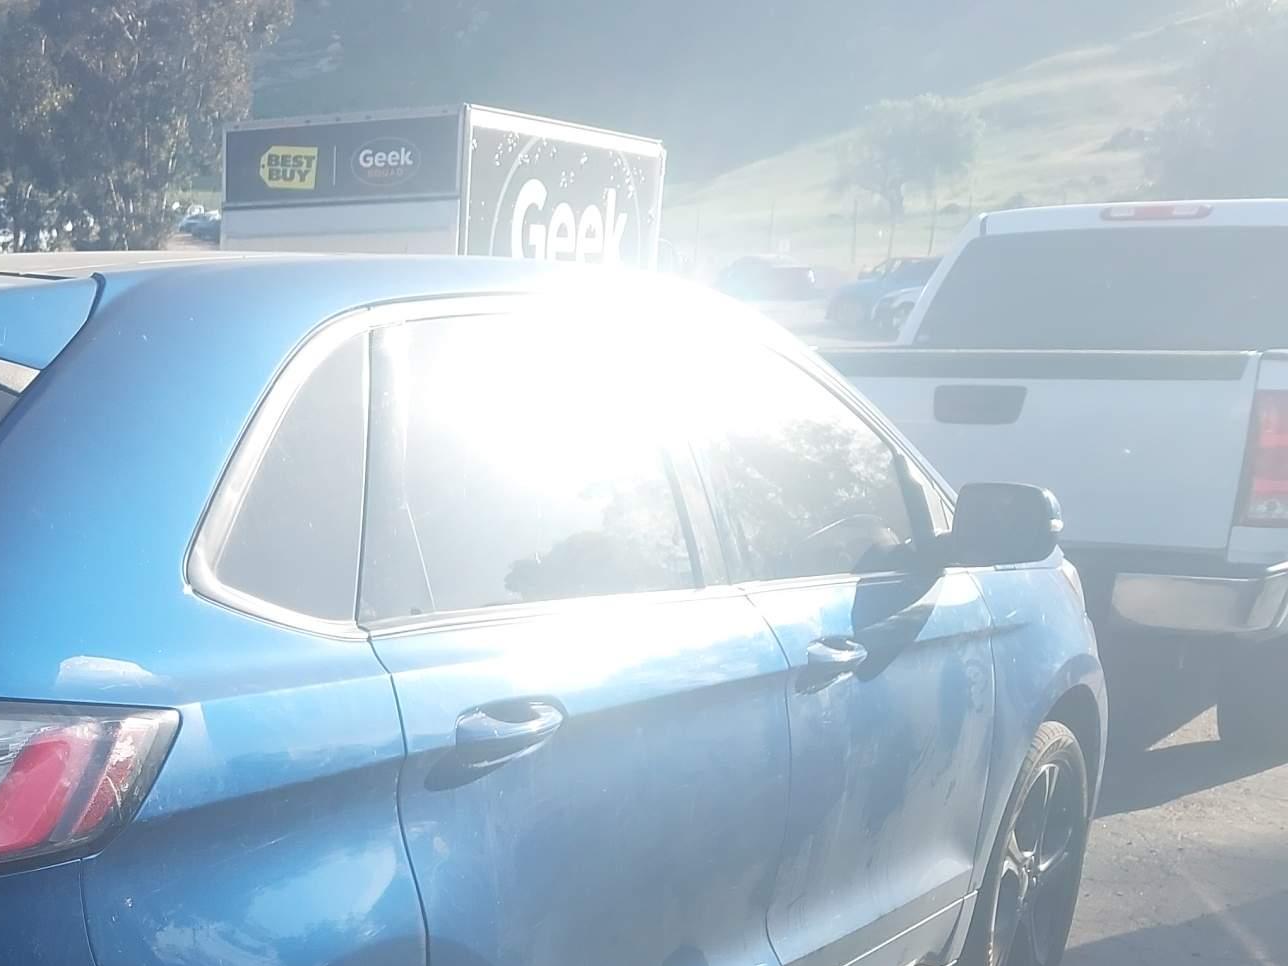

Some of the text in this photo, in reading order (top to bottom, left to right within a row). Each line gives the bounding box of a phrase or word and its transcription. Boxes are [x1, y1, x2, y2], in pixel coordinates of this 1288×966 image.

[267, 154, 316, 169] BEST
[358, 147, 414, 169] Geek
[268, 169, 310, 183] BUY
[511, 178, 629, 262] Geek
